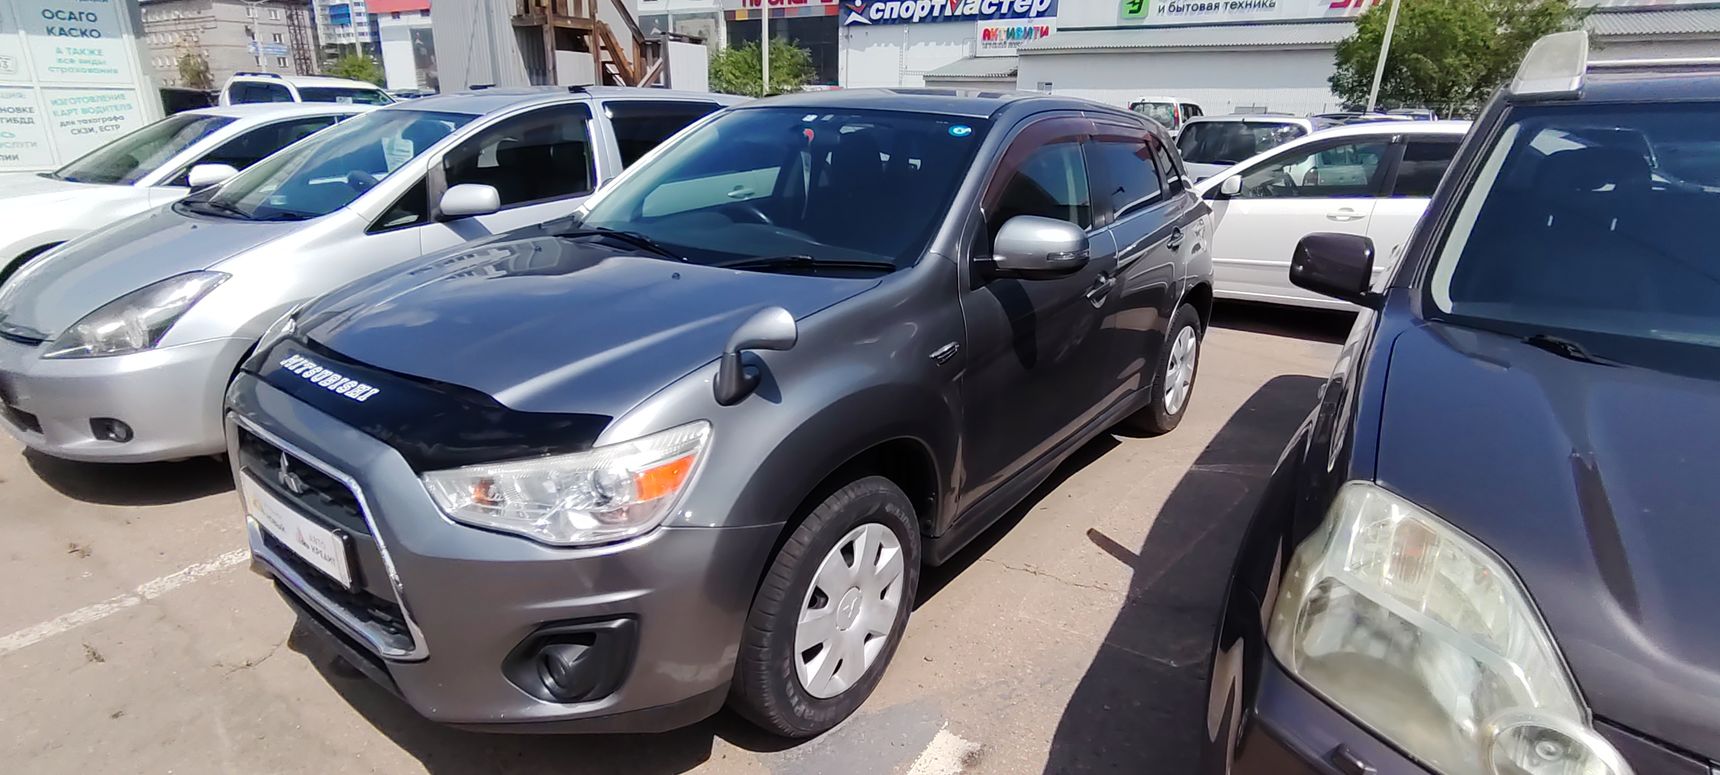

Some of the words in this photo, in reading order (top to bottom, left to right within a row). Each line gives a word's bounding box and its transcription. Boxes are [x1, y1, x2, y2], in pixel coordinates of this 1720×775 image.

[1158, 6, 1165, 14] и
[1168, 3, 1220, 13] бытовая
[1223, 0, 1276, 11] техника
[41, 9, 98, 22] ОСАГО
[46, 26, 102, 38] КАСКО
[65, 47, 104, 56] ТАКЖЕ
[50, 93, 126, 106] ИЗГОТОВЛЕНИЕ
[53, 108, 79, 117] КАРТ
[80, 103, 133, 114] ВОДИТЕЛЯ
[79, 115, 125, 126] тахографа
[100, 124, 121, 133] ЕСТР
[280, 354, 380, 402] MITSUBISHI
